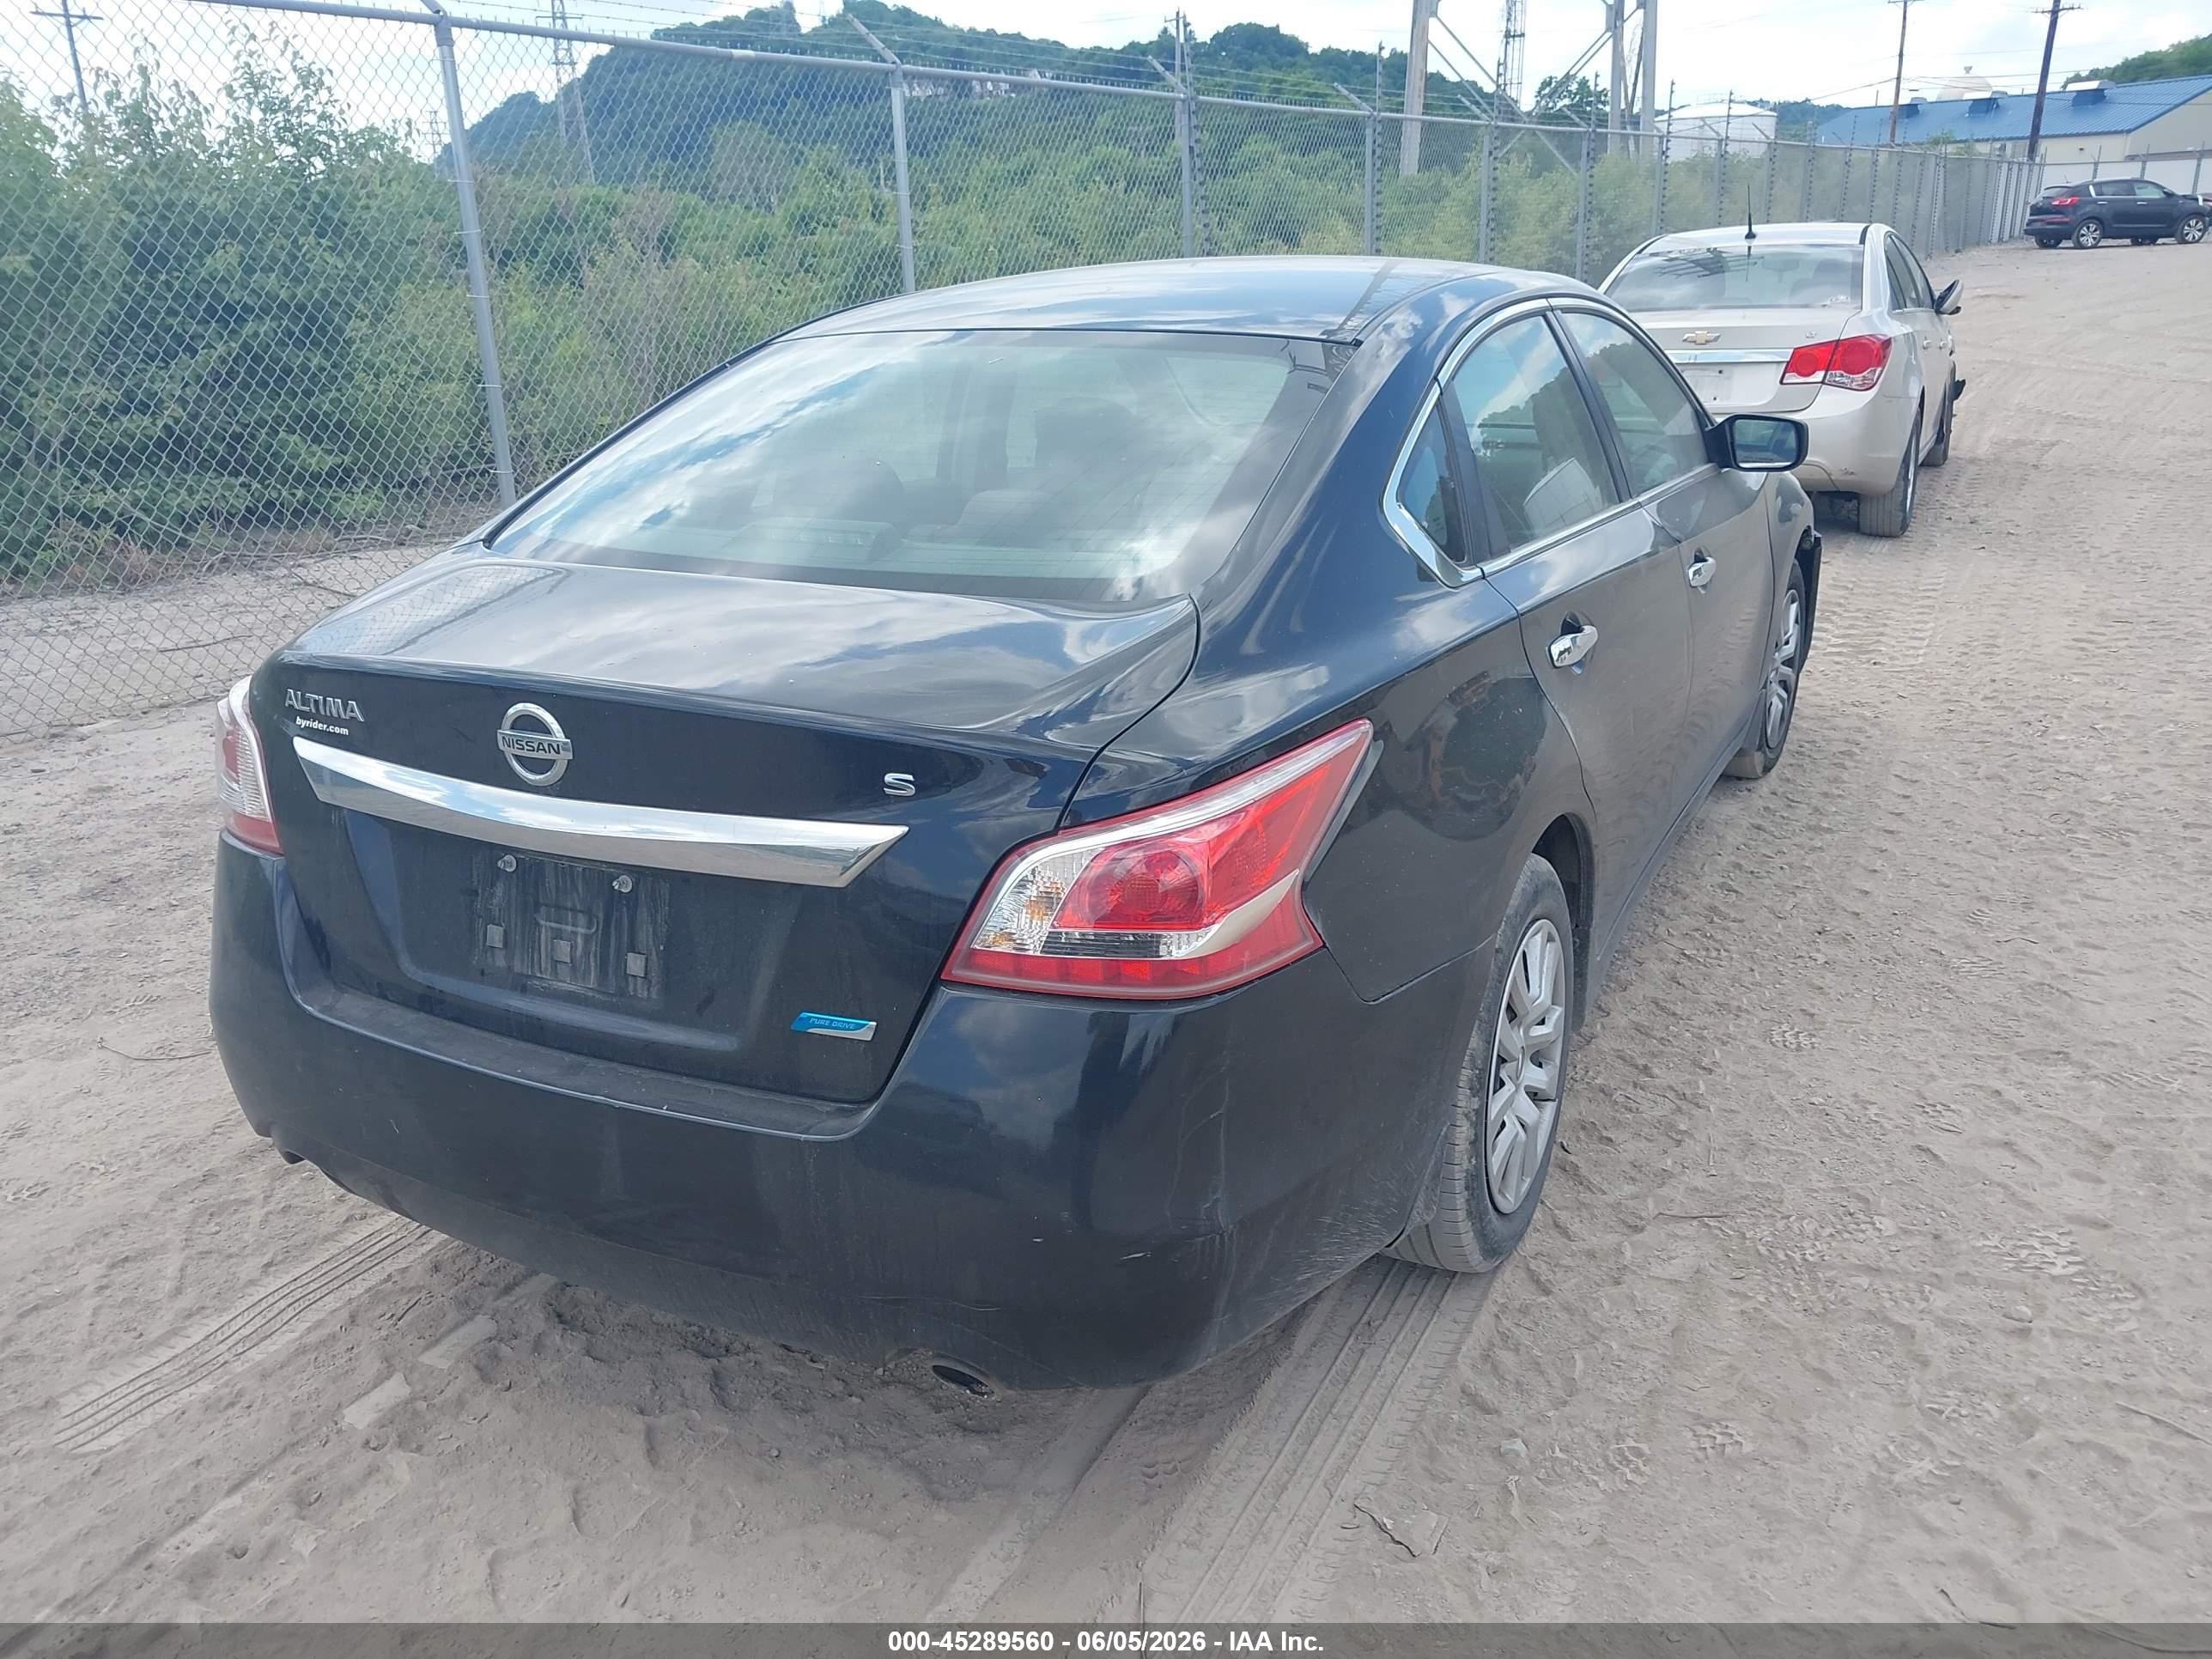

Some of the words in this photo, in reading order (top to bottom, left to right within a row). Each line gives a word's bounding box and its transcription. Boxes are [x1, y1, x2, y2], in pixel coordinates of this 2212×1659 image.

[284, 689, 365, 722] ALTIMA
[295, 715, 349, 736] byrider.com
[501, 735, 562, 755] NISSAN
[883, 772, 915, 797] S
[810, 1018, 830, 1026] PURE
[831, 1021, 856, 1030] DRIVE
